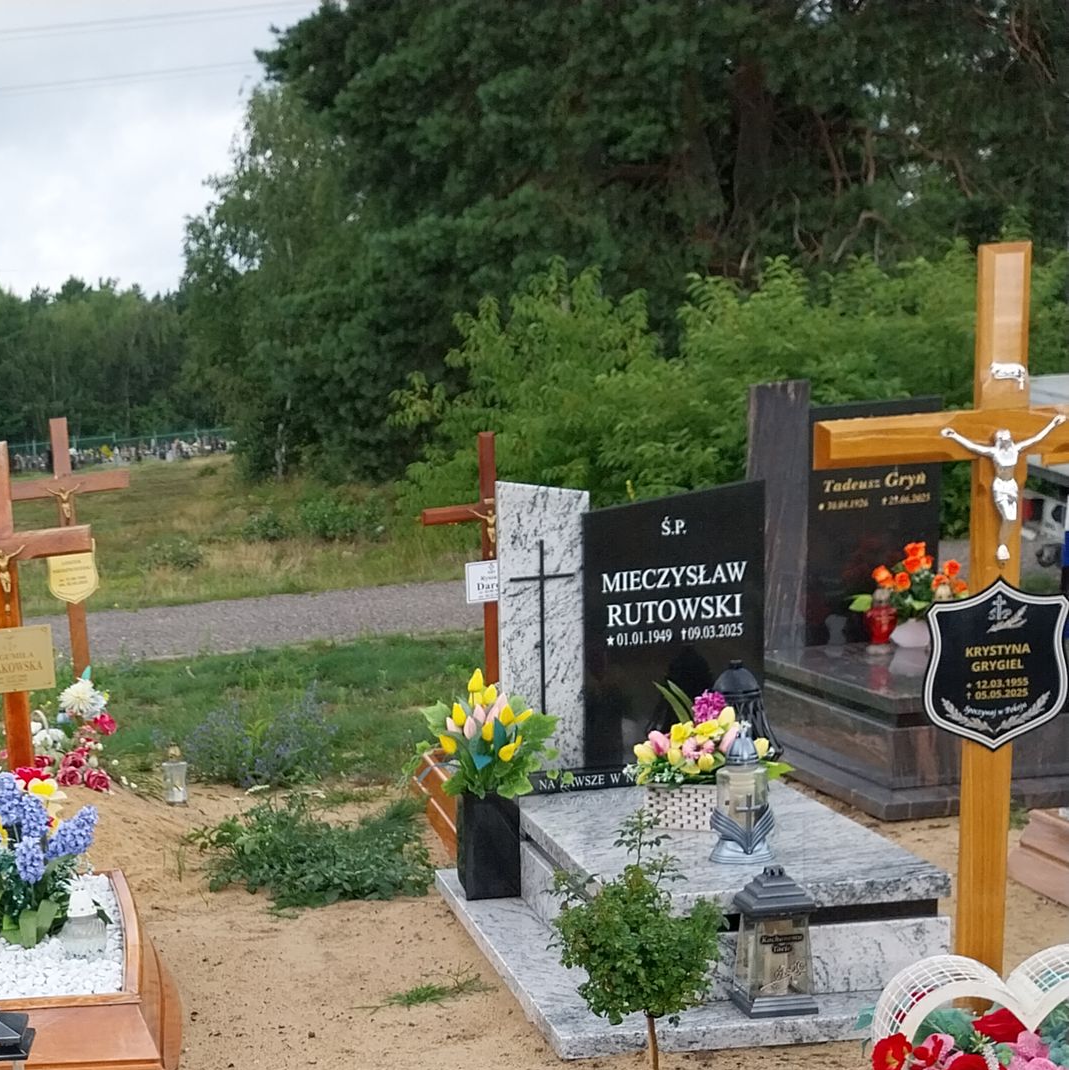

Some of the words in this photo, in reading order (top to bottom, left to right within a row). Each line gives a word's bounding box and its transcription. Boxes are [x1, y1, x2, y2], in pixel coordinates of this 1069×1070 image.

[823, 478, 881, 493] Tadeusz
[661, 516, 687, 536] Ś.P.
[601, 560, 748, 594] MIECZYSŁAW
[606, 593, 743, 628] RUTOWSKI
[616, 628, 673, 646] 01.01.1949
[687, 622, 744, 640] 09.03.2025
[964, 643, 1031, 658] KRYSTYNA
[971, 658, 1025, 673] GRYGIEL
[975, 677, 1029, 690] 12.03.1955
[974, 687, 1029, 700] 05.05.2025
[539, 780, 556, 791] NA
[610, 772, 622, 783] W
